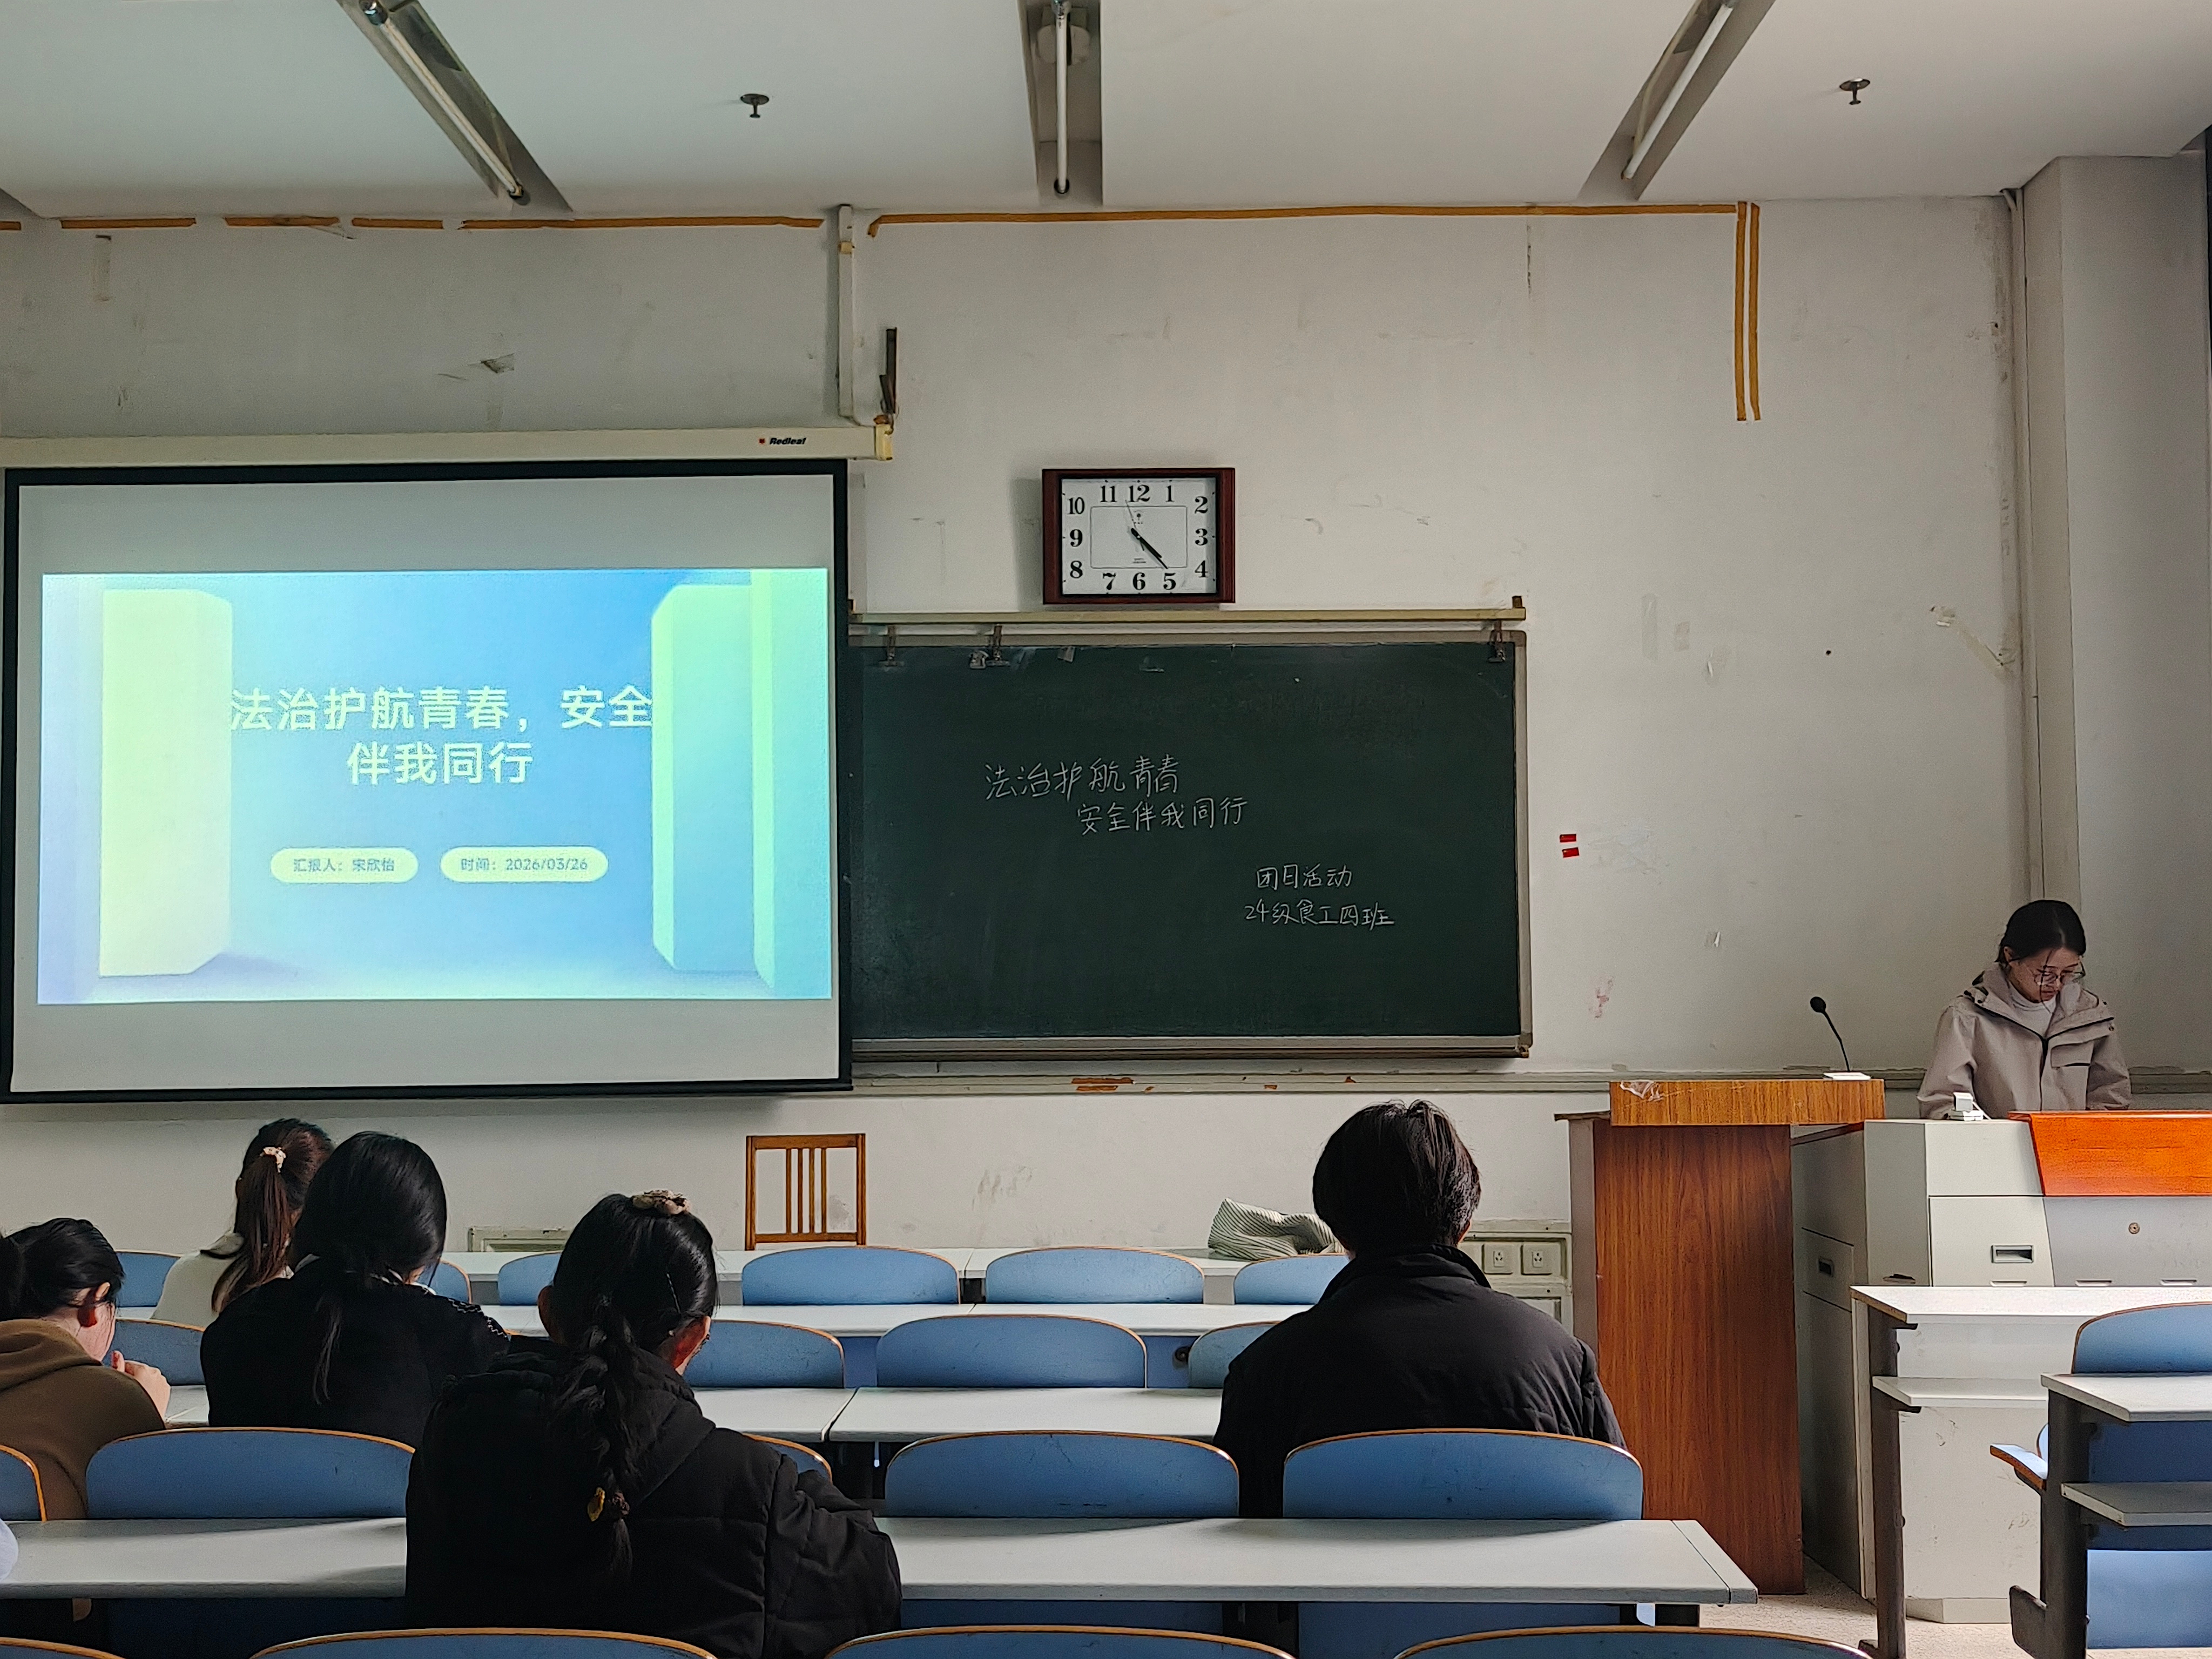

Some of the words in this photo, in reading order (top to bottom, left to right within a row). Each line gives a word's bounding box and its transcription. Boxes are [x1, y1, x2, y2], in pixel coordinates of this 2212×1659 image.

[1100, 485, 1117, 502] 11
[1128, 485, 1150, 503] 12
[1165, 485, 1175, 502] 1
[1067, 497, 1085, 515] 10
[1195, 496, 1208, 514] 2
[1070, 529, 1083, 547] 9
[1195, 529, 1208, 546] 3
[1070, 561, 1083, 578] 8
[1195, 560, 1208, 578] 4
[1103, 573, 1116, 590] 7
[1132, 572, 1145, 590] 6
[1163, 573, 1176, 590] 5
[347, 741, 533, 785] 伴我同行
[984, 754, 1179, 801] 法治护航青春
[1077, 797, 1248, 836] 安全伴我同行
[1256, 863, 1352, 890] 团日活动
[1244, 898, 1395, 931] 24级食工四班
